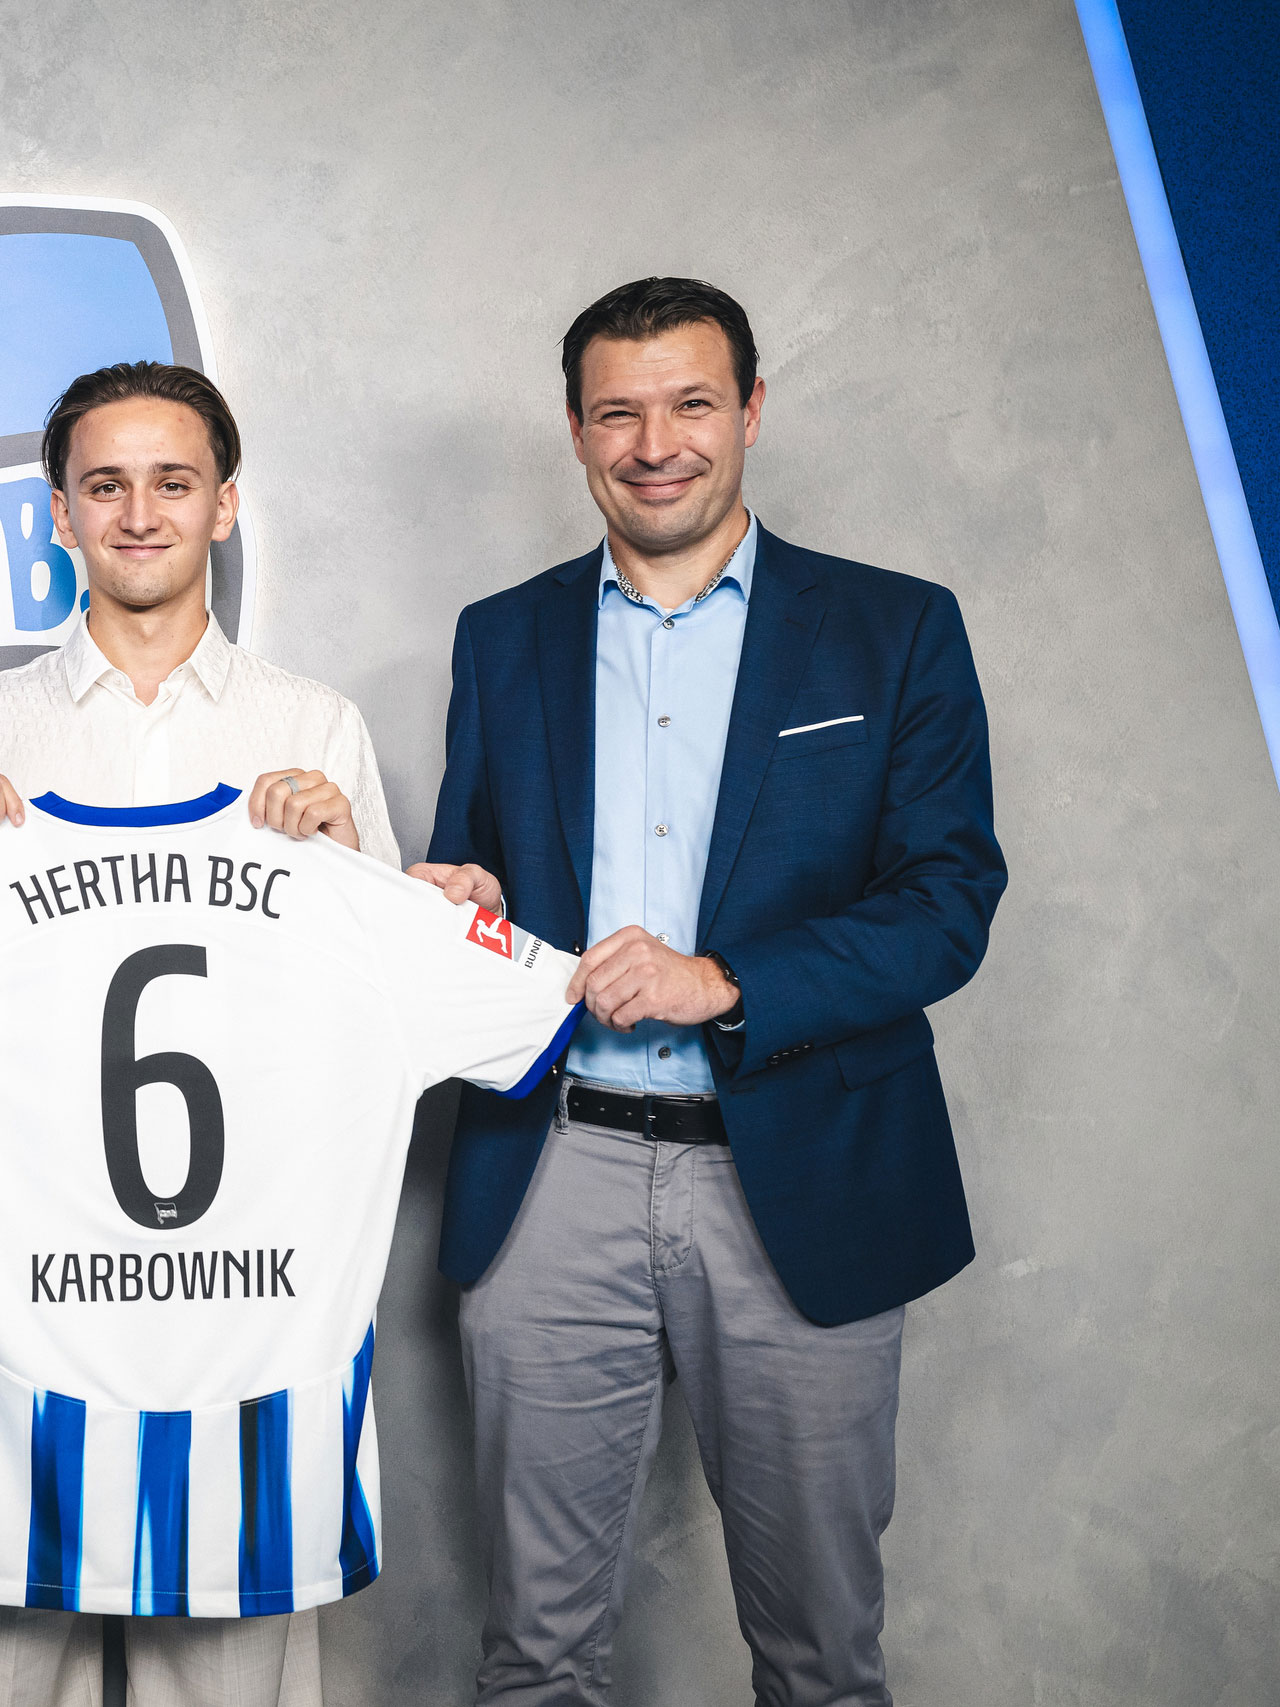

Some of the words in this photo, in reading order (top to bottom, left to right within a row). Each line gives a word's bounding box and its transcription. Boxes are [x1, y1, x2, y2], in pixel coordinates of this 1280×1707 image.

[10, 853, 191, 924] HERTHA
[209, 856, 290, 919] BSC
[524, 937, 543, 969] BUND
[101, 944, 224, 1230] 6
[32, 1249, 295, 1302] KARBOWNIK
